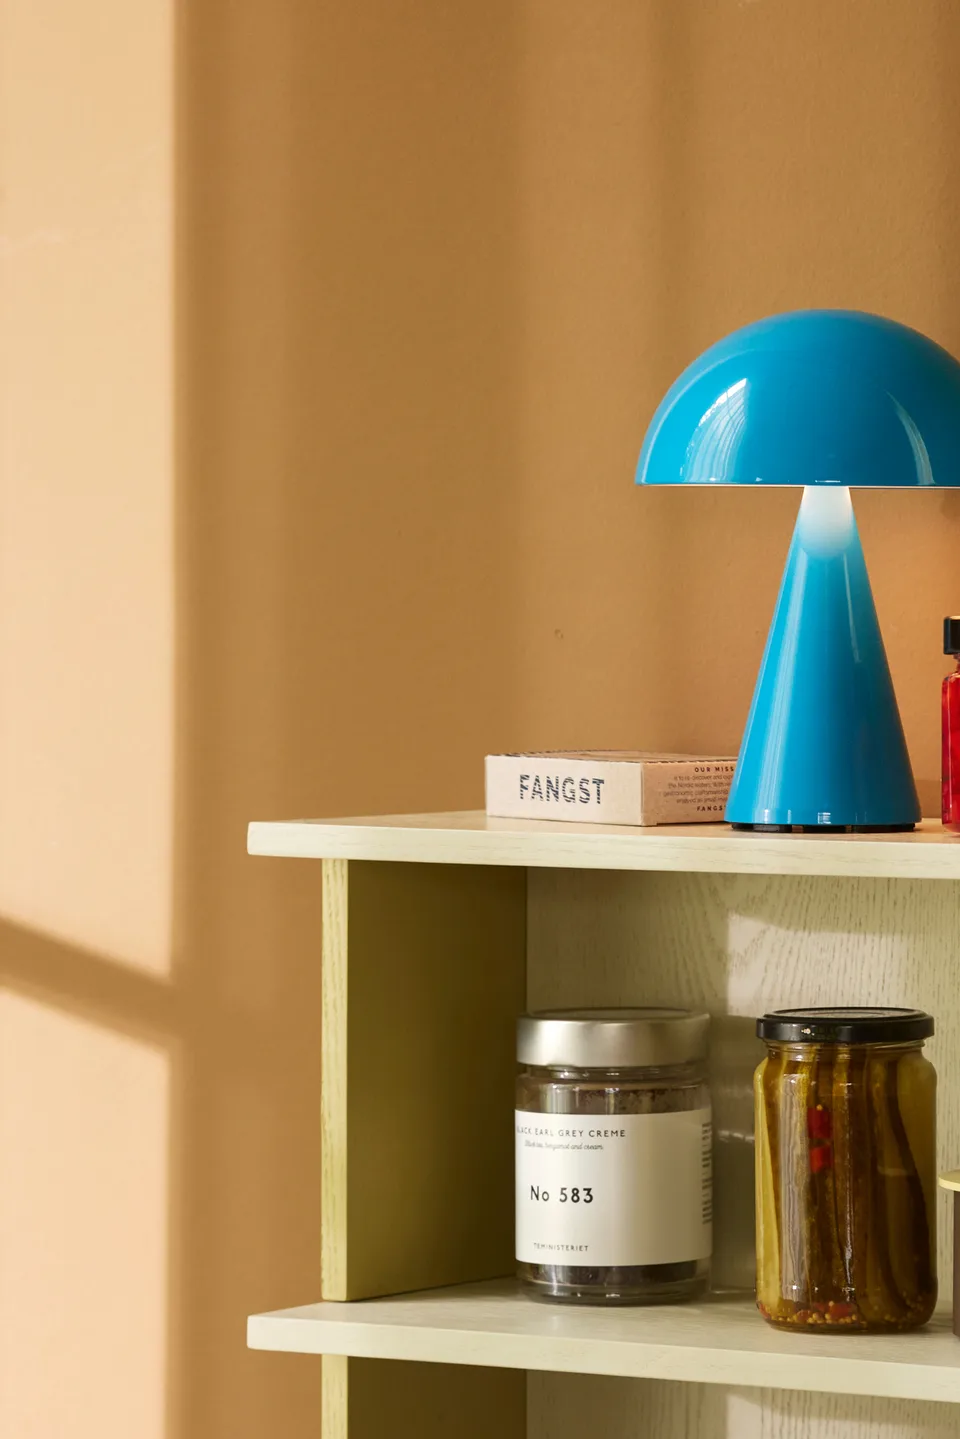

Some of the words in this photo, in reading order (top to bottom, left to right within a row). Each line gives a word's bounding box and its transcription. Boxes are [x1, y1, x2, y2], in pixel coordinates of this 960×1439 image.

[519, 773, 605, 805] FANGST
[535, 1128, 554, 1137] EARL
[558, 1129, 584, 1138] GREY
[588, 1129, 626, 1138] CREME
[530, 1185, 550, 1202] No
[559, 1187, 594, 1204] 583
